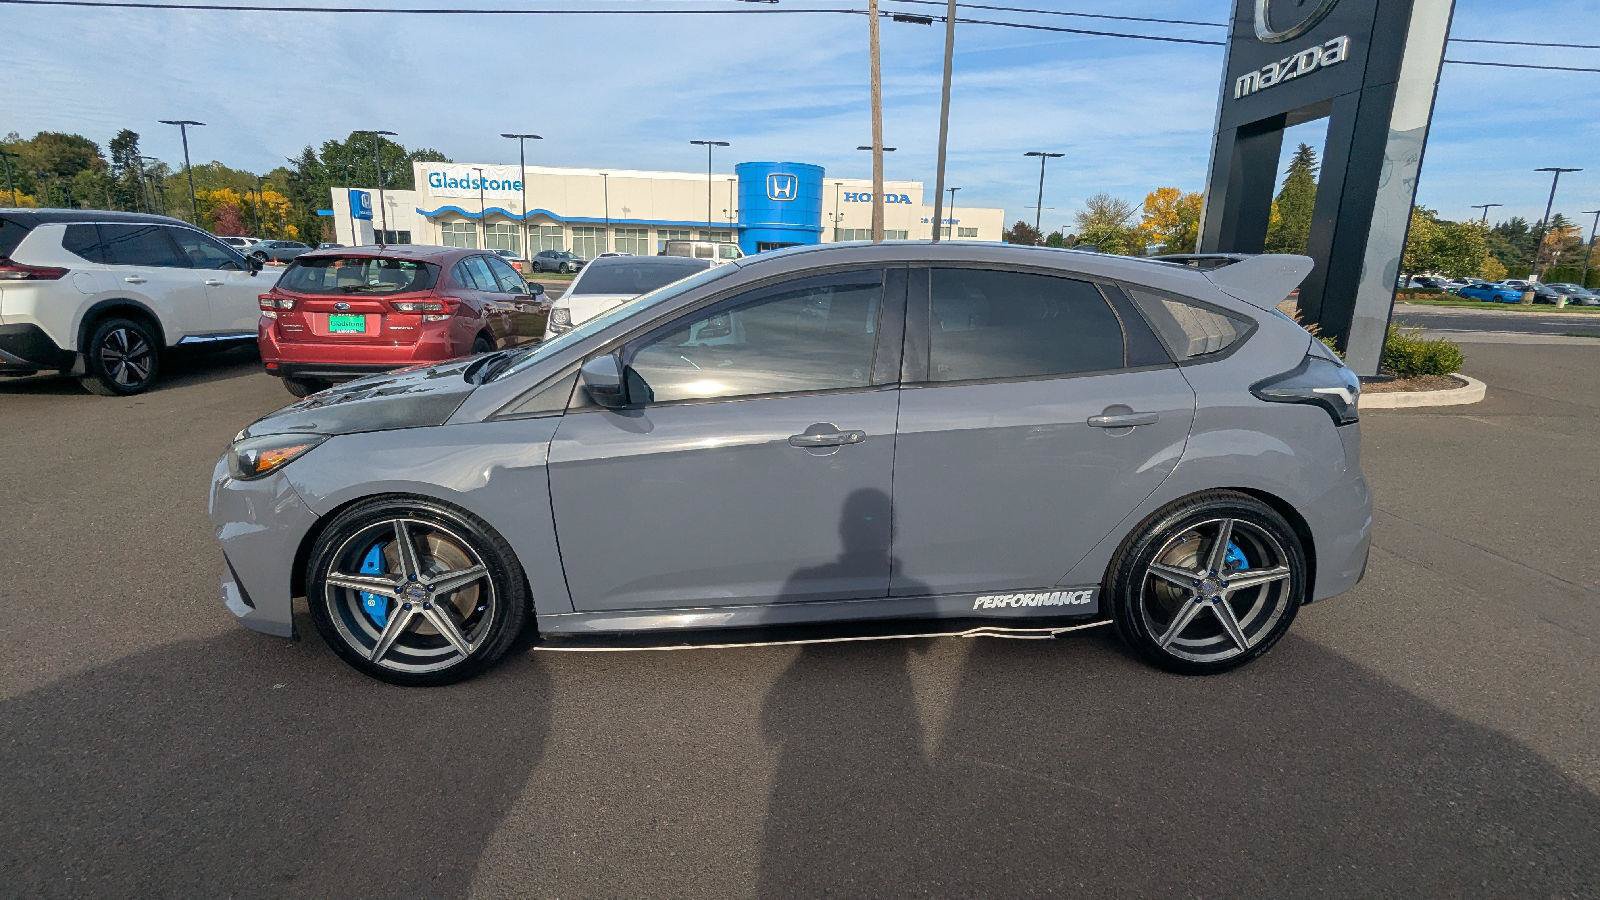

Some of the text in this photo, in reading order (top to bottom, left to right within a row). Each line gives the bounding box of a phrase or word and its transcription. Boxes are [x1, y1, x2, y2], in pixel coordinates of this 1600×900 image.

[429, 172, 525, 191] Gladstone
[844, 191, 912, 204] HODA
[973, 590, 1094, 610] PERFORMANCE
